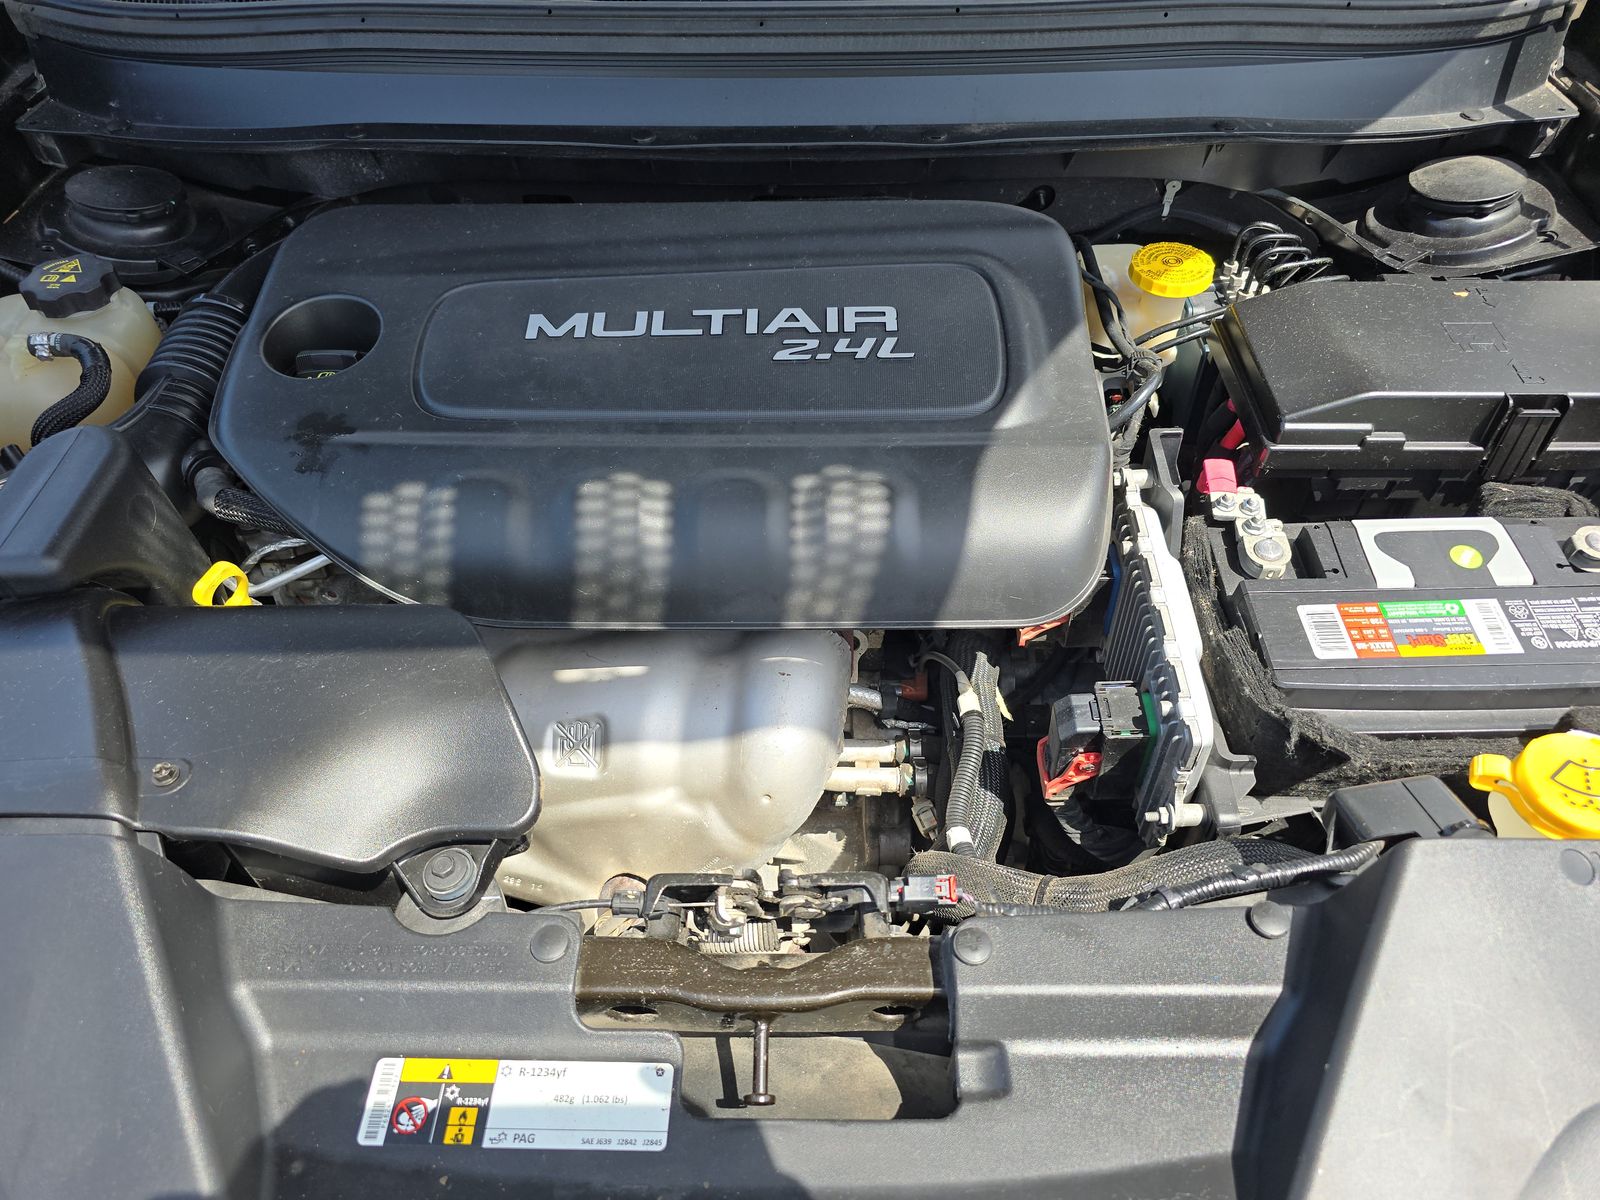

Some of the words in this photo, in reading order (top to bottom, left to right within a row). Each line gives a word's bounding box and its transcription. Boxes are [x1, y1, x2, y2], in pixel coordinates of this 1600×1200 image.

[525, 305, 899, 339] MULTIAIR
[772, 337, 916, 361] 2.4L
[519, 1066, 568, 1079] R-1234yf
[553, 1094, 575, 1105] 482g
[581, 1094, 610, 1105] (1.062
[611, 1094, 628, 1105] lbs)
[512, 1133, 536, 1144] PAG
[581, 1137, 594, 1145] SAE
